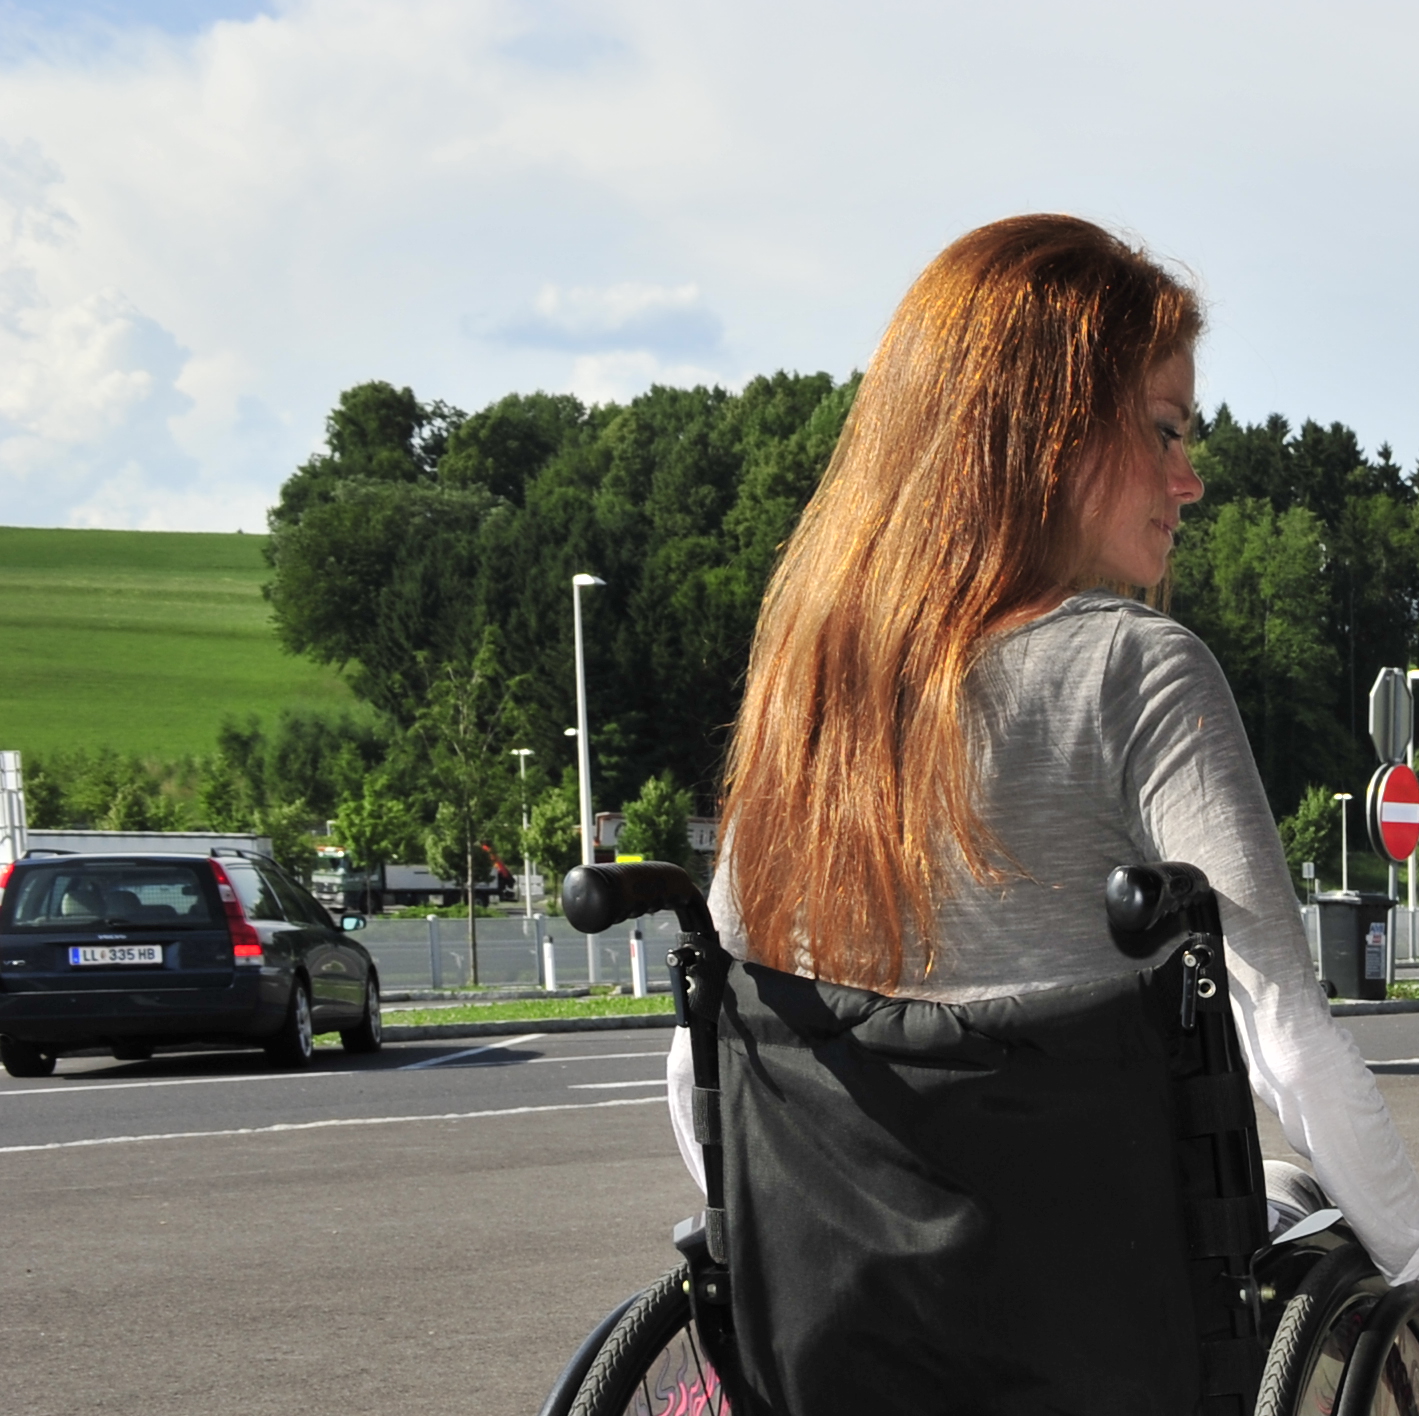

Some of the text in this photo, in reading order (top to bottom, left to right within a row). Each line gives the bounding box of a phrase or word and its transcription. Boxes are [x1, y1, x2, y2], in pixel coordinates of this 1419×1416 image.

[82, 947, 156, 962] LL 335 HB
